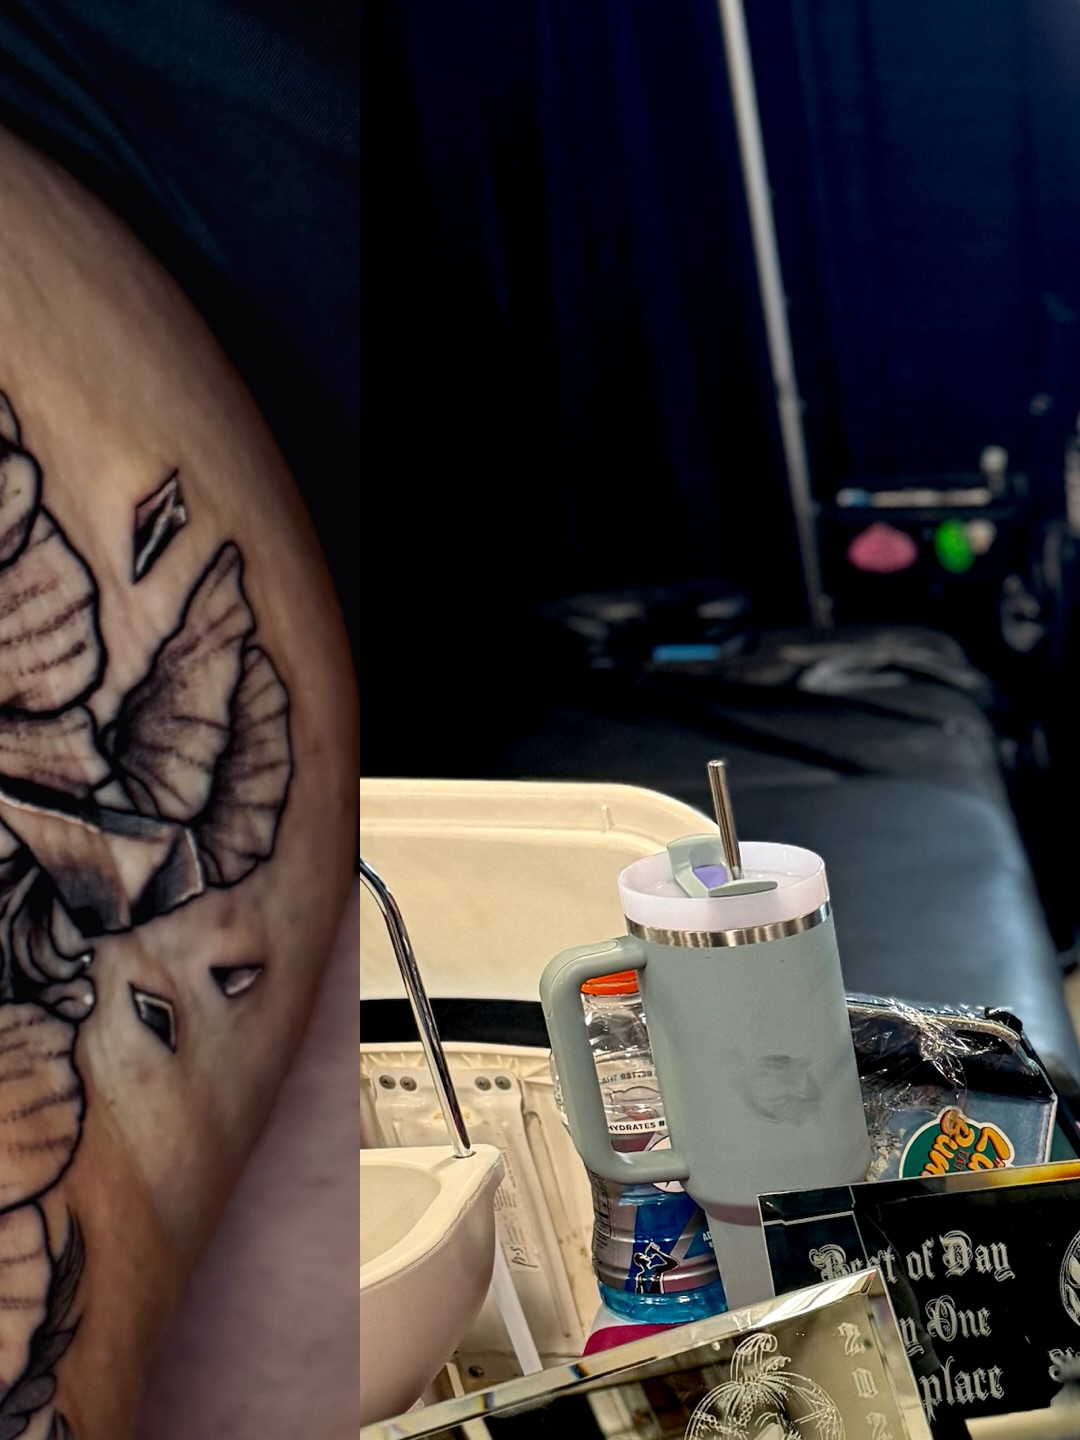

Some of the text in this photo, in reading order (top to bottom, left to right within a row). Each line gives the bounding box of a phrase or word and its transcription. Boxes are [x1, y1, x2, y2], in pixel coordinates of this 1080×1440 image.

[905, 1238, 935, 1281] of
[939, 1230, 1016, 1282] Day
[924, 1295, 992, 1342] One
[919, 1356, 1004, 1424] place
